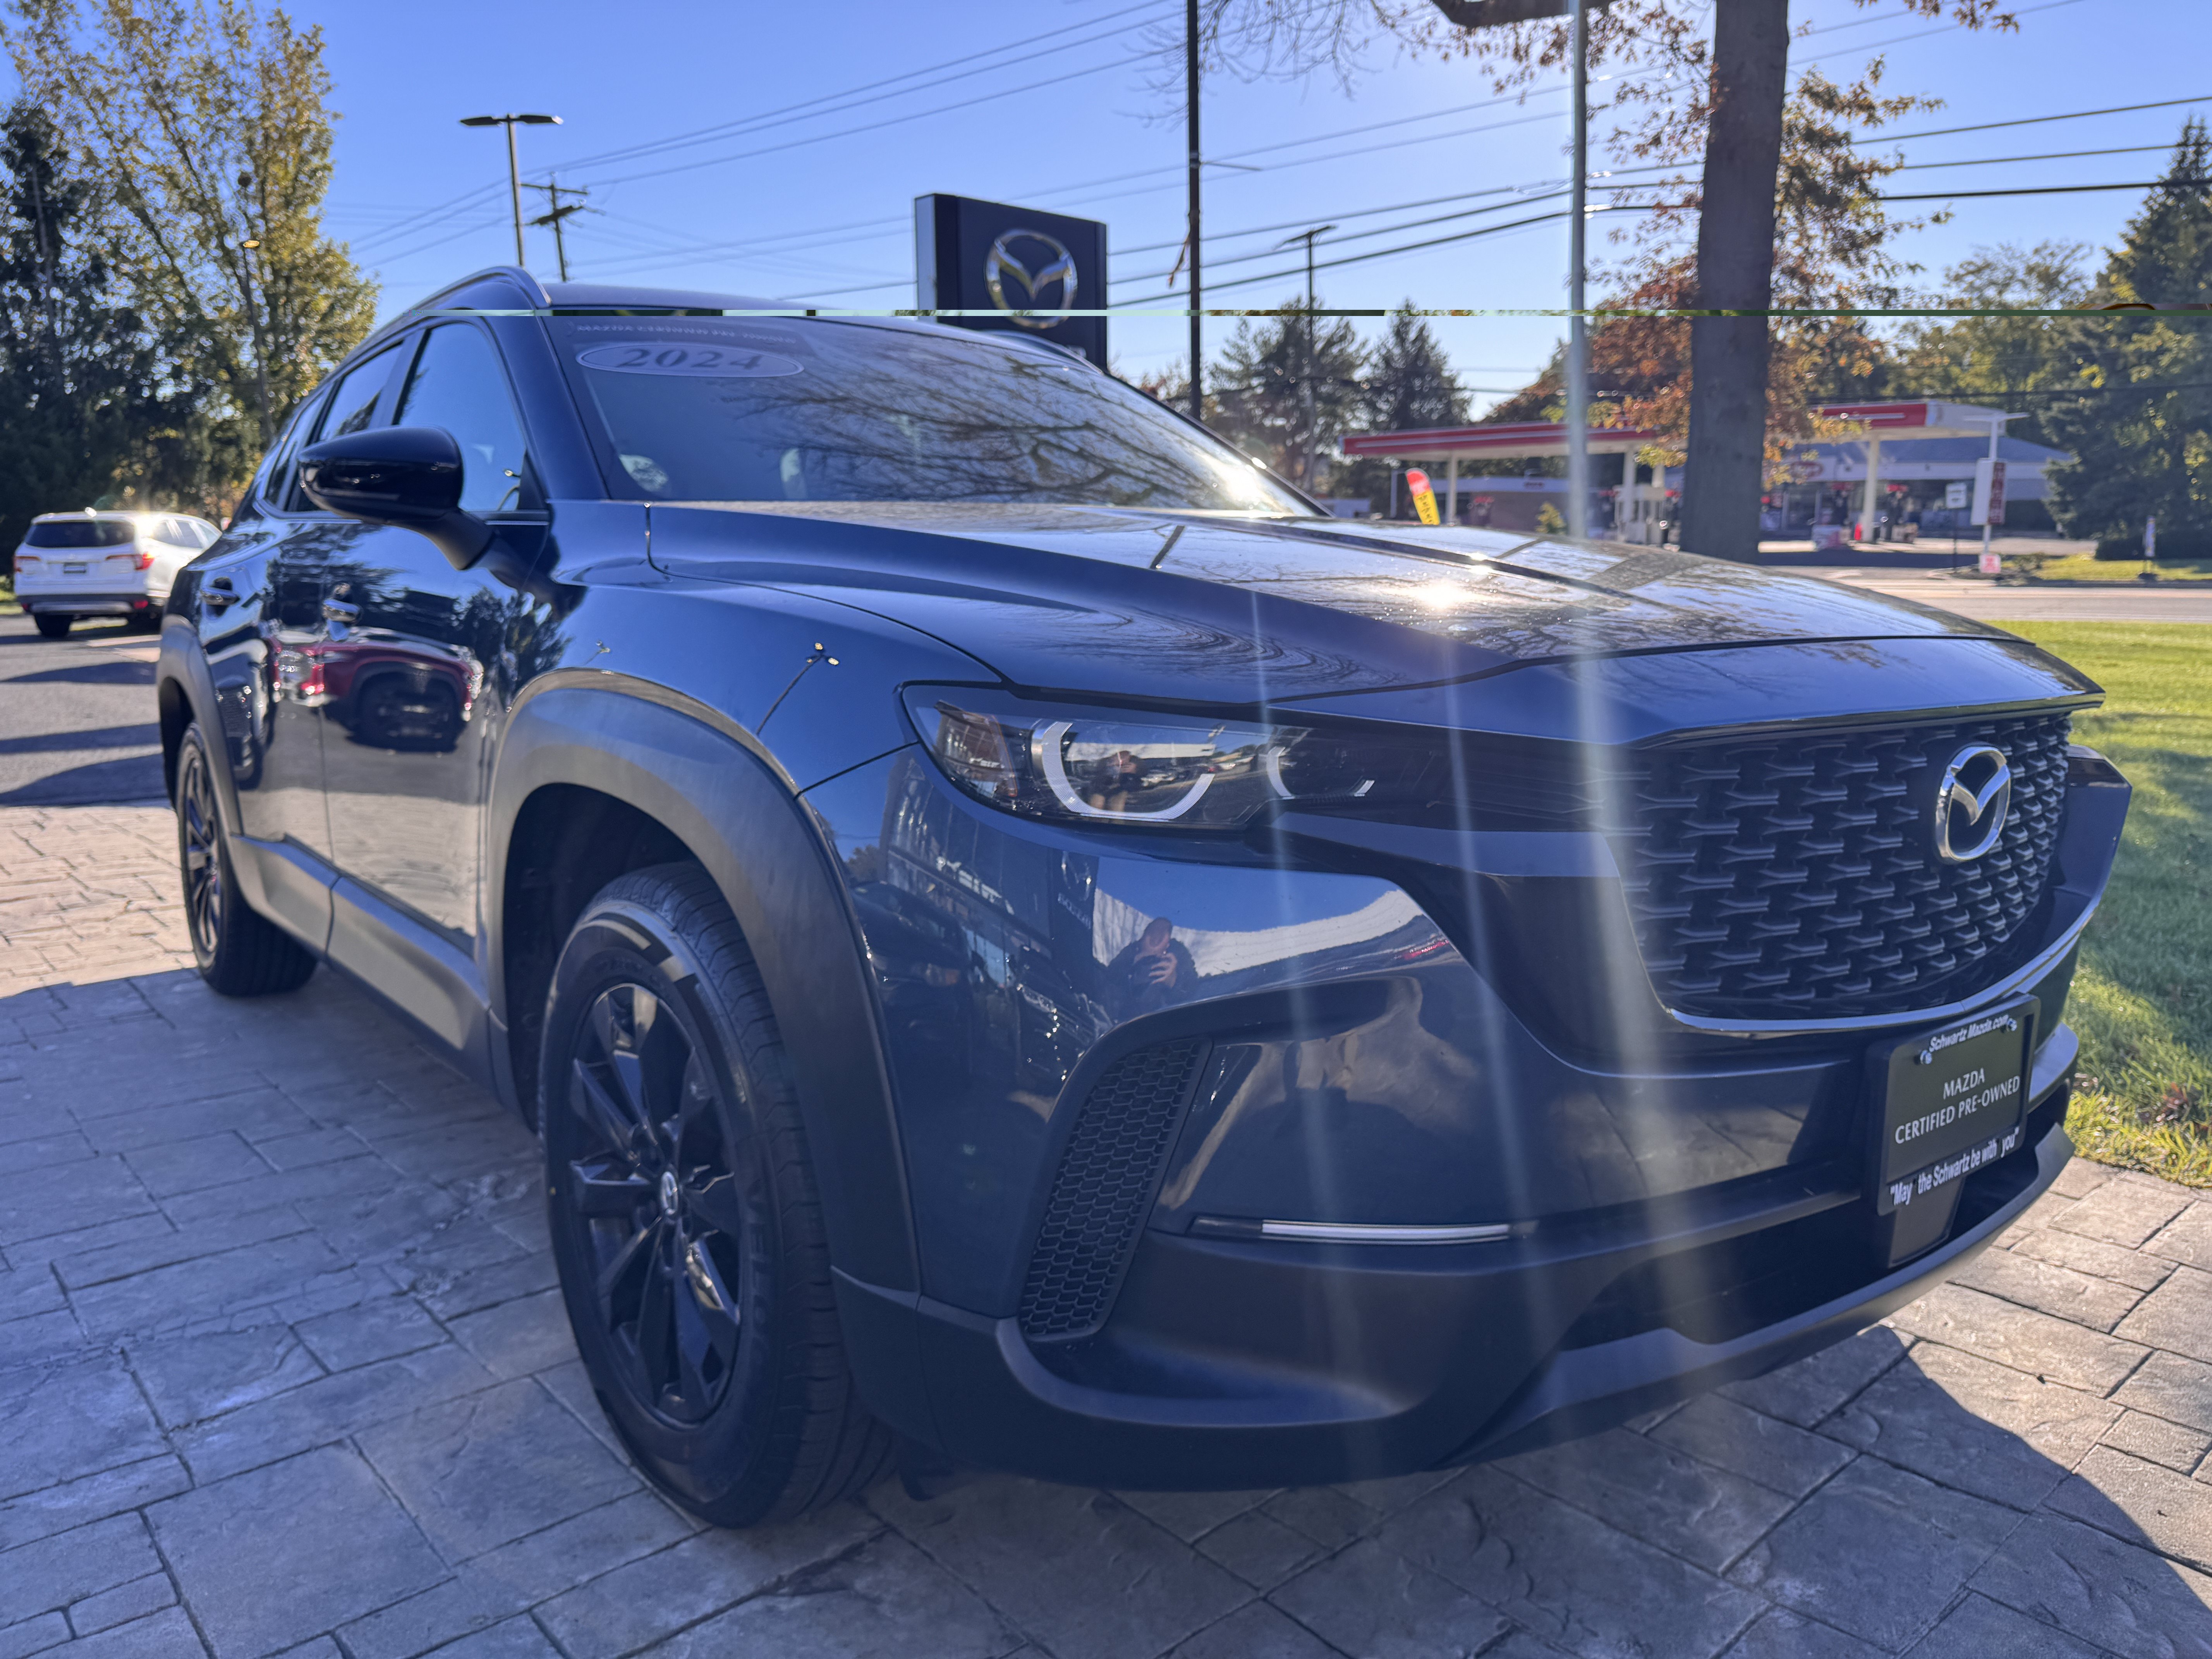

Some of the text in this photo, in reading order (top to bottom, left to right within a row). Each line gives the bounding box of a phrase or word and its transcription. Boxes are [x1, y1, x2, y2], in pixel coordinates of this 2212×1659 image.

[616, 349, 763, 370] 2024
[1929, 1028, 1967, 1053] Schwartz
[1943, 1067, 1985, 1100] MAZDA
[1895, 1075, 2020, 1144] CERTIFIED PRE-OWNED
[1918, 1172, 1933, 1195] the
[1933, 1152, 1970, 1187] Schwartz
[1970, 1148, 1982, 1169] be
[1981, 1138, 1997, 1163] with
